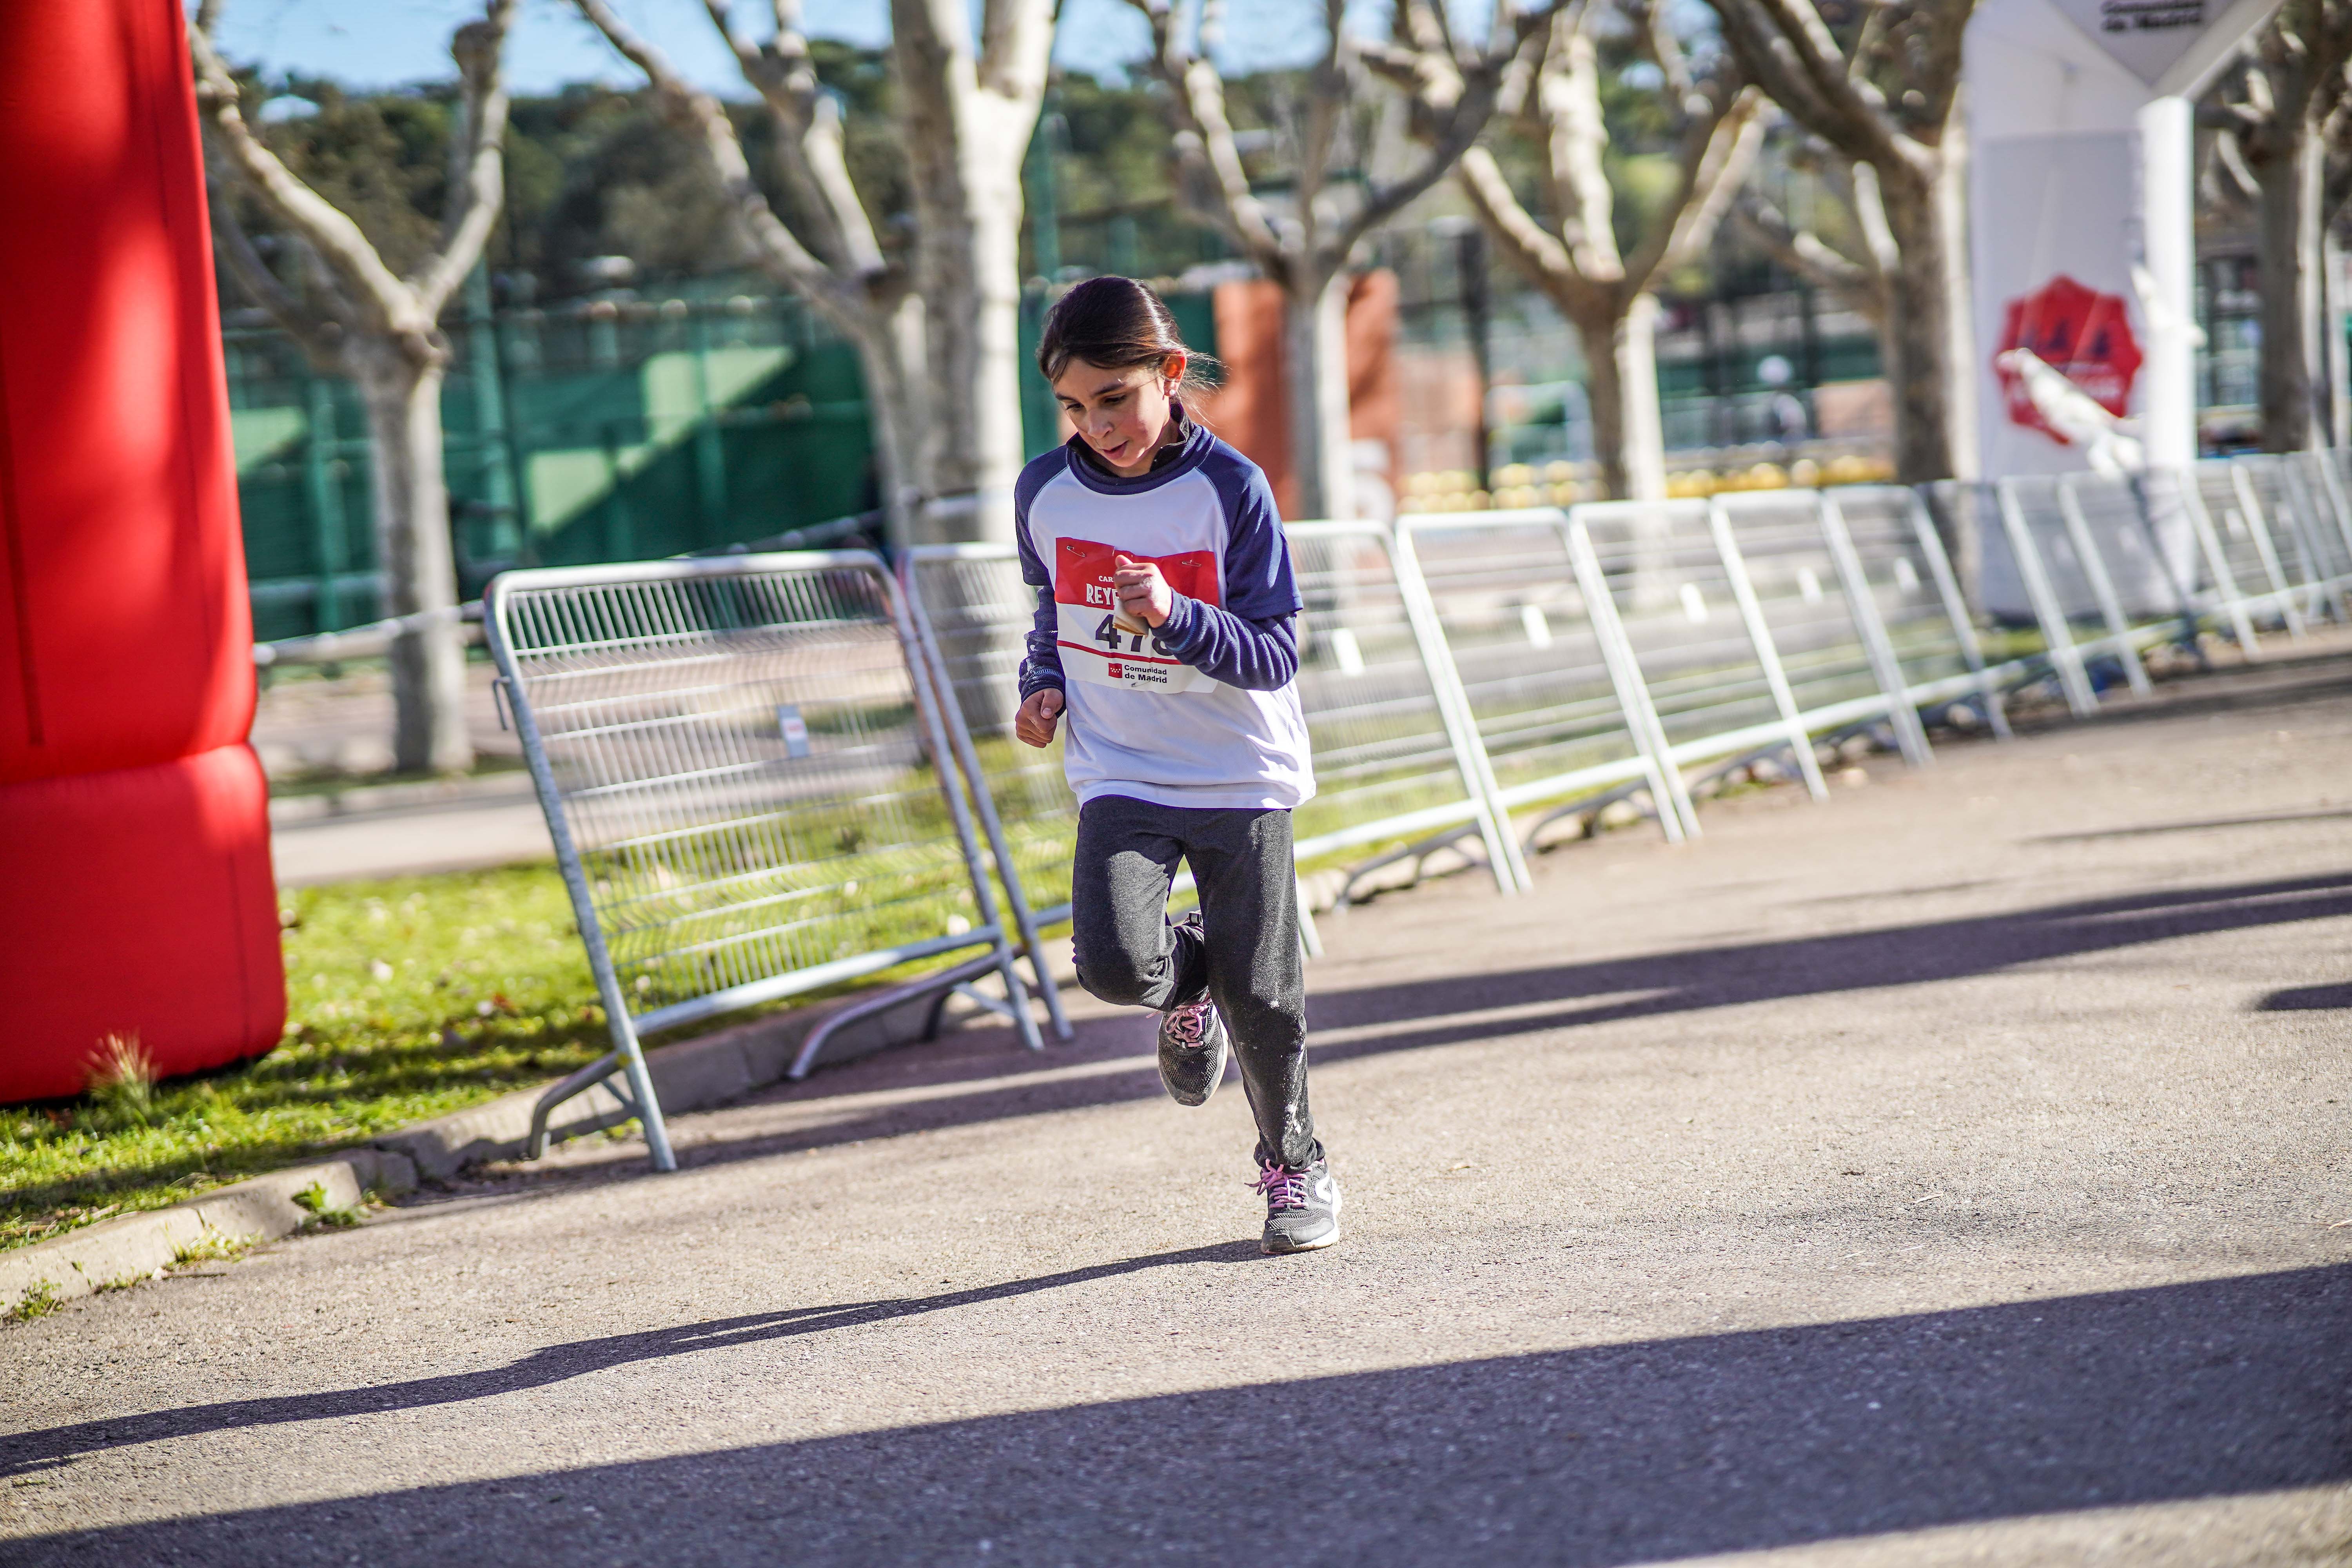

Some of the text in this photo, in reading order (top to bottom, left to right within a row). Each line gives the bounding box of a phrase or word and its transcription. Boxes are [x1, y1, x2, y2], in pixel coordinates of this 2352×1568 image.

[1086, 583, 1120, 606] REYE
[1124, 664, 1167, 675] Comunidad
[1138, 674, 1167, 683] Madrid
